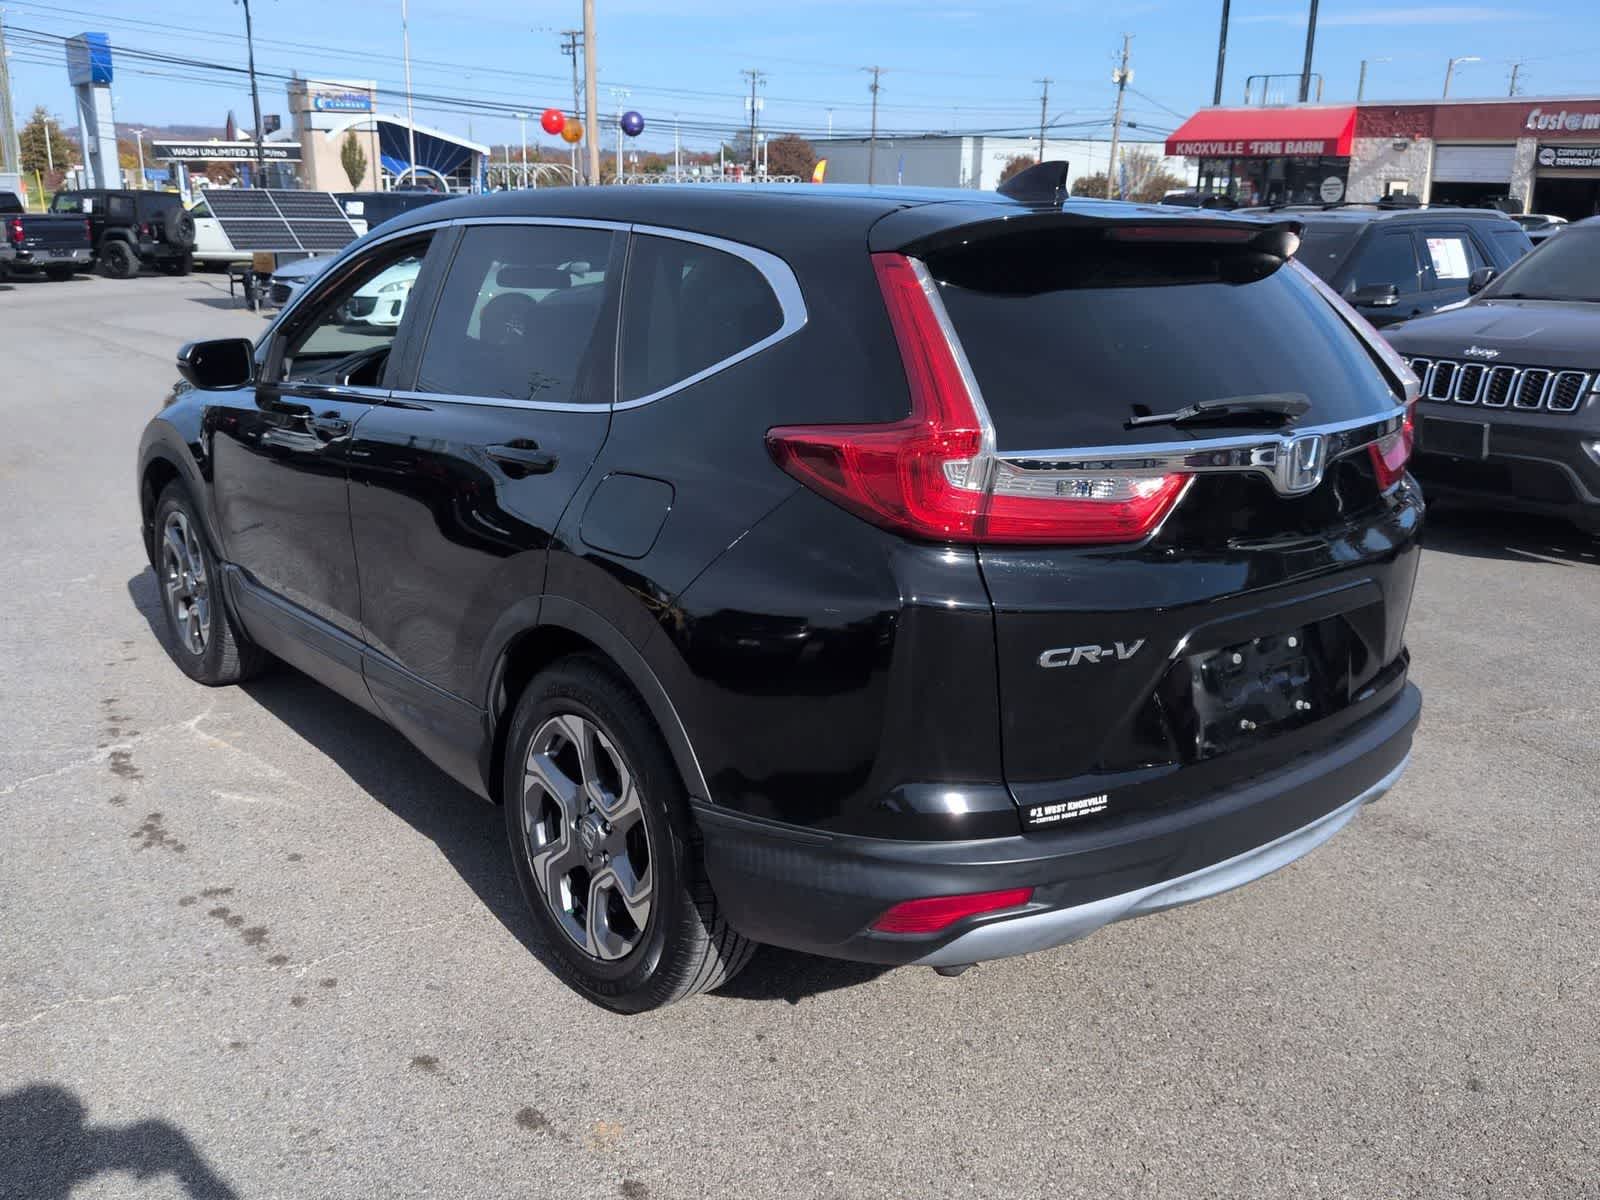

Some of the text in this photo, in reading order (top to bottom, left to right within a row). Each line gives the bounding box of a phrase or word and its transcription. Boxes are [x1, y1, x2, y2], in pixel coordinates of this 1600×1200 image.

[172, 148, 199, 156] WASH
[200, 149, 247, 157] UNLIMITED
[1176, 141, 1244, 155] KNOXVILLE
[1285, 140, 1325, 154] BARN
[1464, 345, 1501, 359] Jeep
[1039, 638, 1146, 668] CR-V
[1030, 794, 1108, 817] #1 WEST KNOXVILLE
